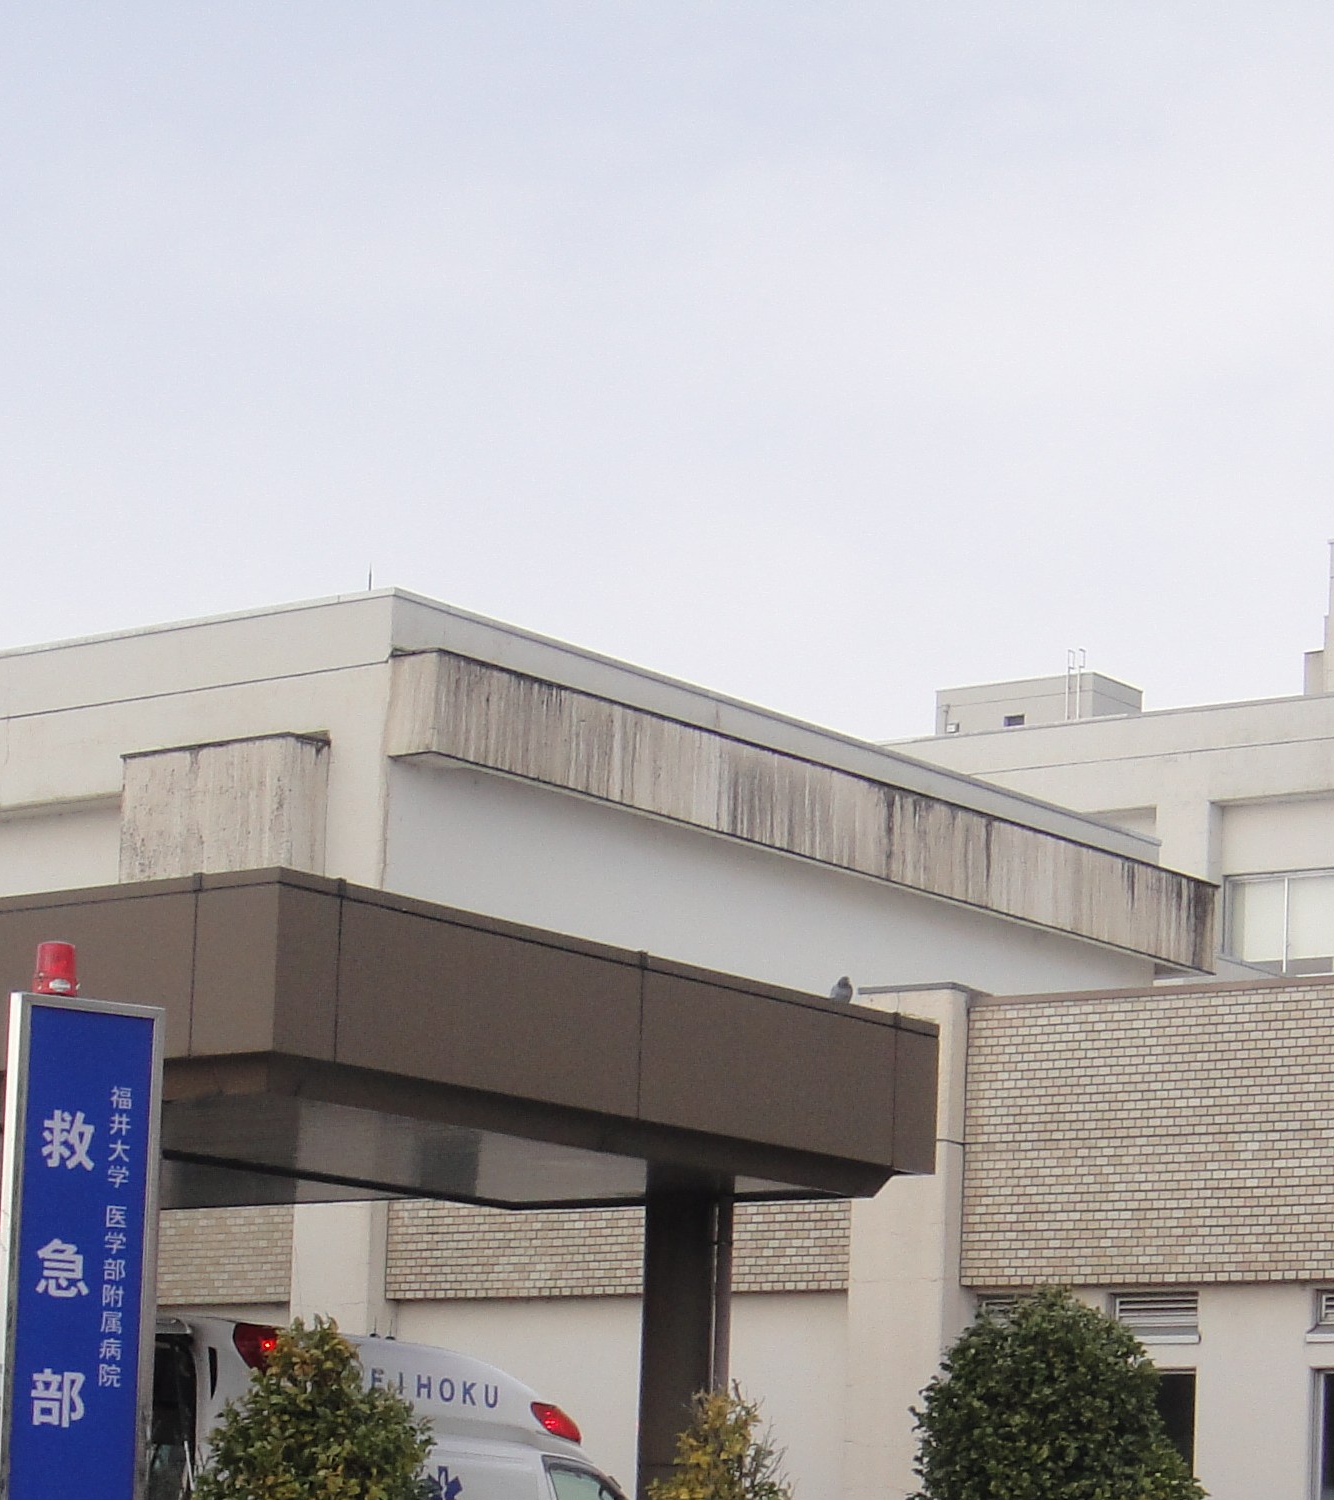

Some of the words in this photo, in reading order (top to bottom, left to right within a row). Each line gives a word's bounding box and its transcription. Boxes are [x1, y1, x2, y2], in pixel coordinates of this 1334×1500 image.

[107, 1086, 132, 1189] 福井大学
[30, 1108, 95, 1428] 救急部
[98, 1205, 127, 1388] 医学部附属病院
